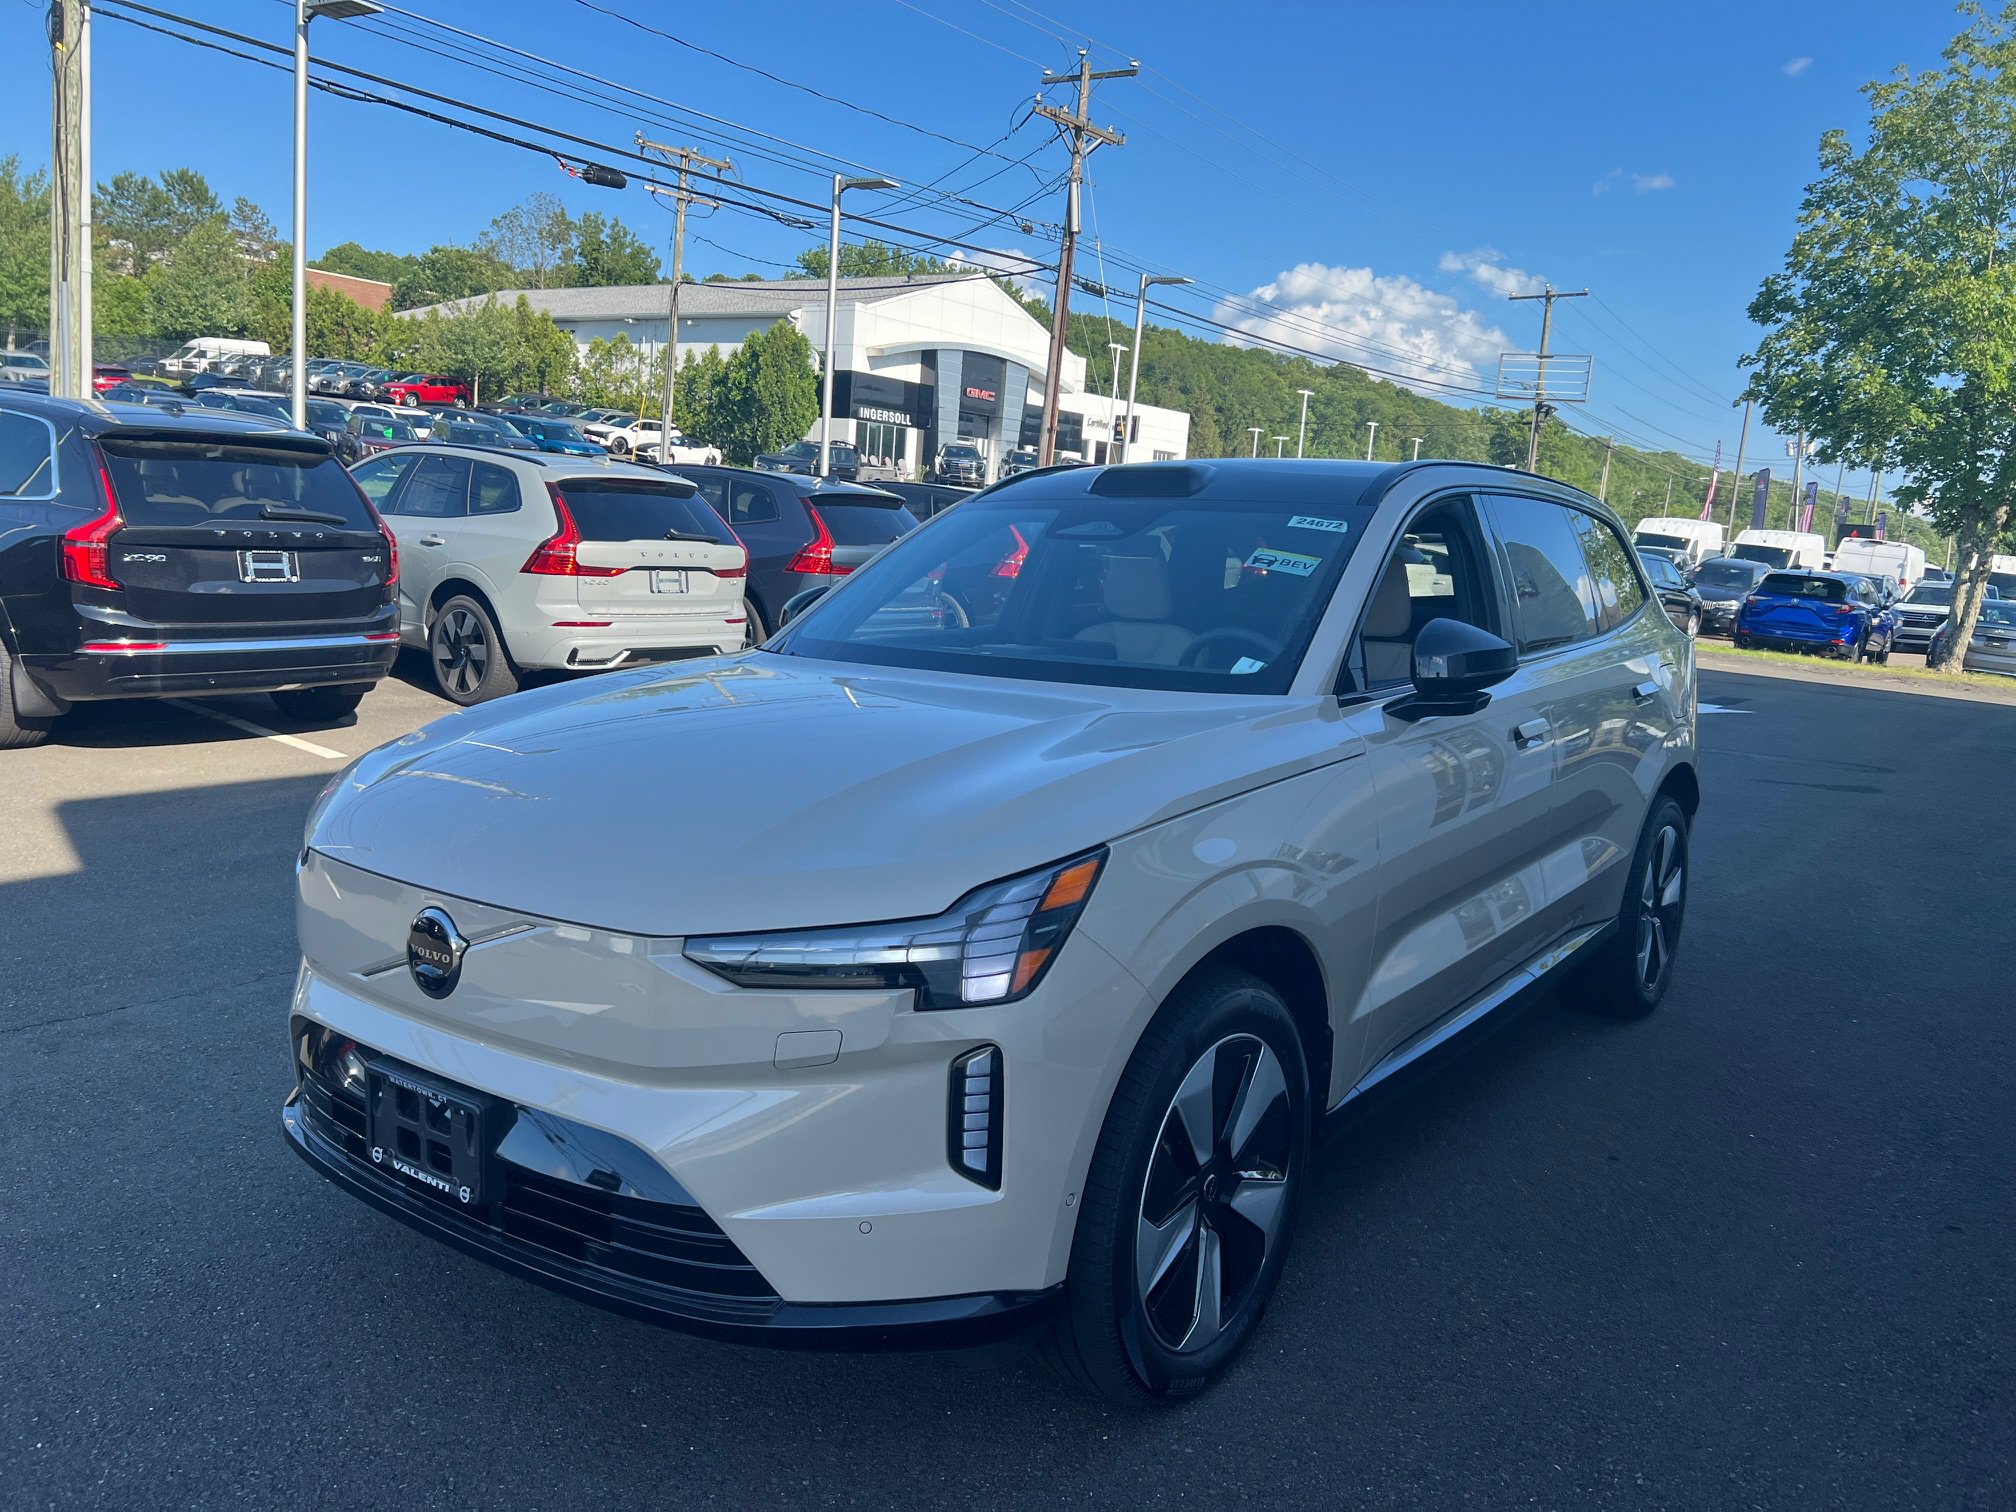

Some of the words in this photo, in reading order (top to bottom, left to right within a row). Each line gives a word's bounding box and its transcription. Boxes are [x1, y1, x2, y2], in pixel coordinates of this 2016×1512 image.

[966, 387, 996, 401] GMC
[858, 407, 912, 425] INGERSOLL
[1296, 517, 1344, 530] 24672
[213, 529, 324, 539] VOLVO
[123, 553, 167, 563] XC90
[641, 551, 709, 559] VOLVO
[1279, 558, 1314, 571] BEV
[410, 943, 451, 964] VOLVO
[438, 1095, 448, 1104] CT
[393, 1160, 450, 1193] VALENTI
